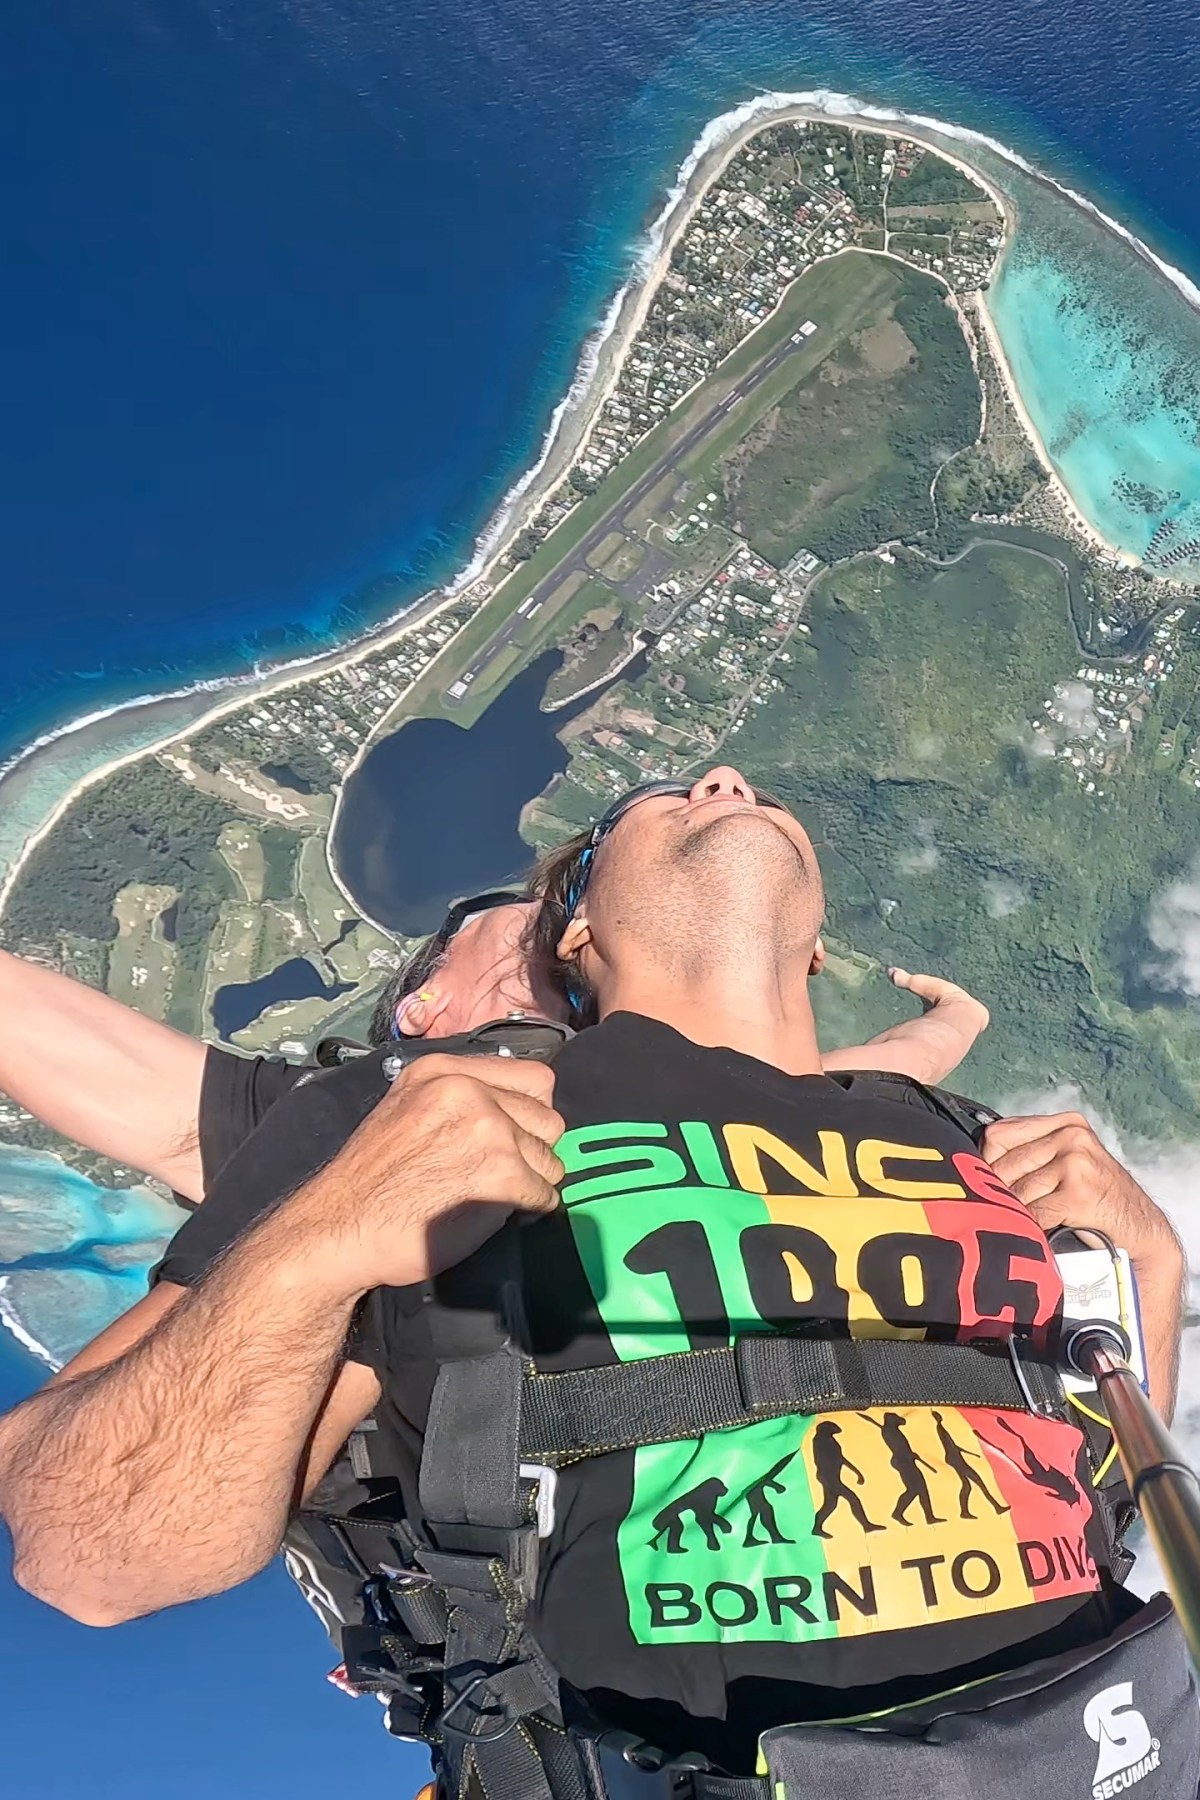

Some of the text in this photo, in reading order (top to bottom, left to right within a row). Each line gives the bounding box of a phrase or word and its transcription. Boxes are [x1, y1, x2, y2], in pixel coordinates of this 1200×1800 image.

[645, 1536, 1097, 1628] BORN TO DIV
[1092, 1750, 1161, 1800] SECUMAR
